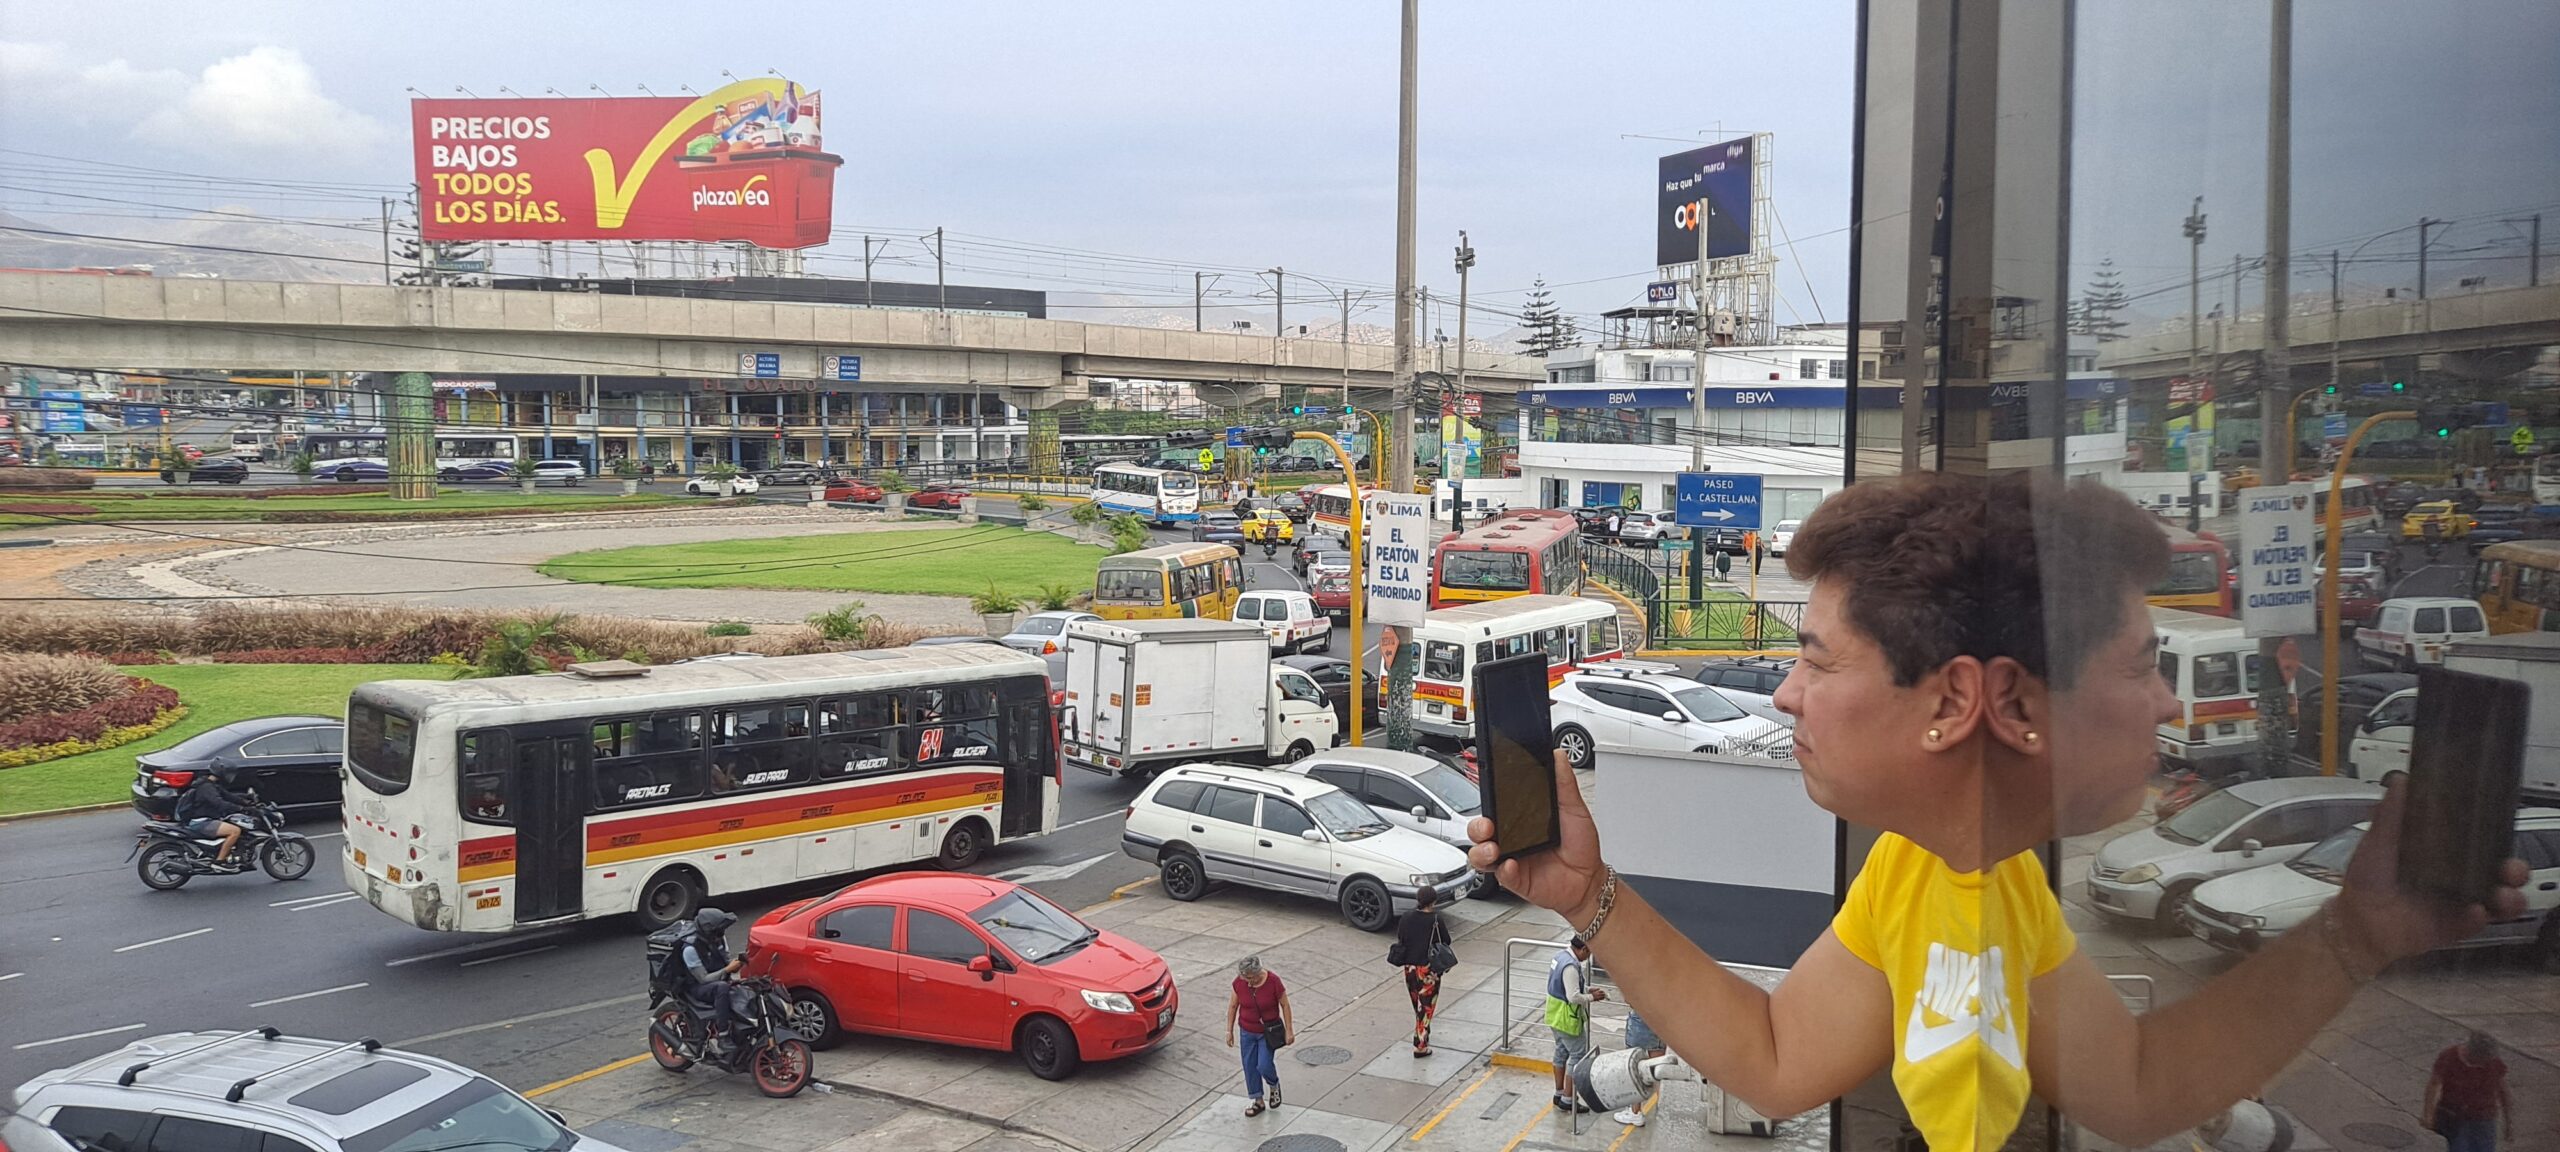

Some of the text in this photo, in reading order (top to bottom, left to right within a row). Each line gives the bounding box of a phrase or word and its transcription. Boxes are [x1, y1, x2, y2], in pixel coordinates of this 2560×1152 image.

[431, 116, 551, 139] PRECIOS
[432, 144, 518, 172] BAJOS
[1703, 161, 1725, 173] marca
[432, 172, 533, 195] TODOS
[1694, 173, 1702, 183] tu
[1666, 179, 1693, 192] Haz que
[435, 194, 567, 223] LOS DÍAS.
[703, 378, 818, 392] EL OVALO
[1531, 394, 1547, 404] BBVA
[1608, 392, 1636, 404] BBVA
[1735, 391, 1775, 404] BBVA
[1704, 479, 1734, 489] PASEO
[1680, 493, 1757, 504] LA CASTELLANA
[1390, 504, 1422, 517] LIMA
[1391, 528, 1404, 543] EL
[1376, 544, 1419, 563] PEATÓN
[1380, 565, 1410, 582] ES LA
[1371, 584, 1422, 601] PRIORIDAD
[917, 728, 943, 762] 24
[625, 783, 672, 800] ARENALES
